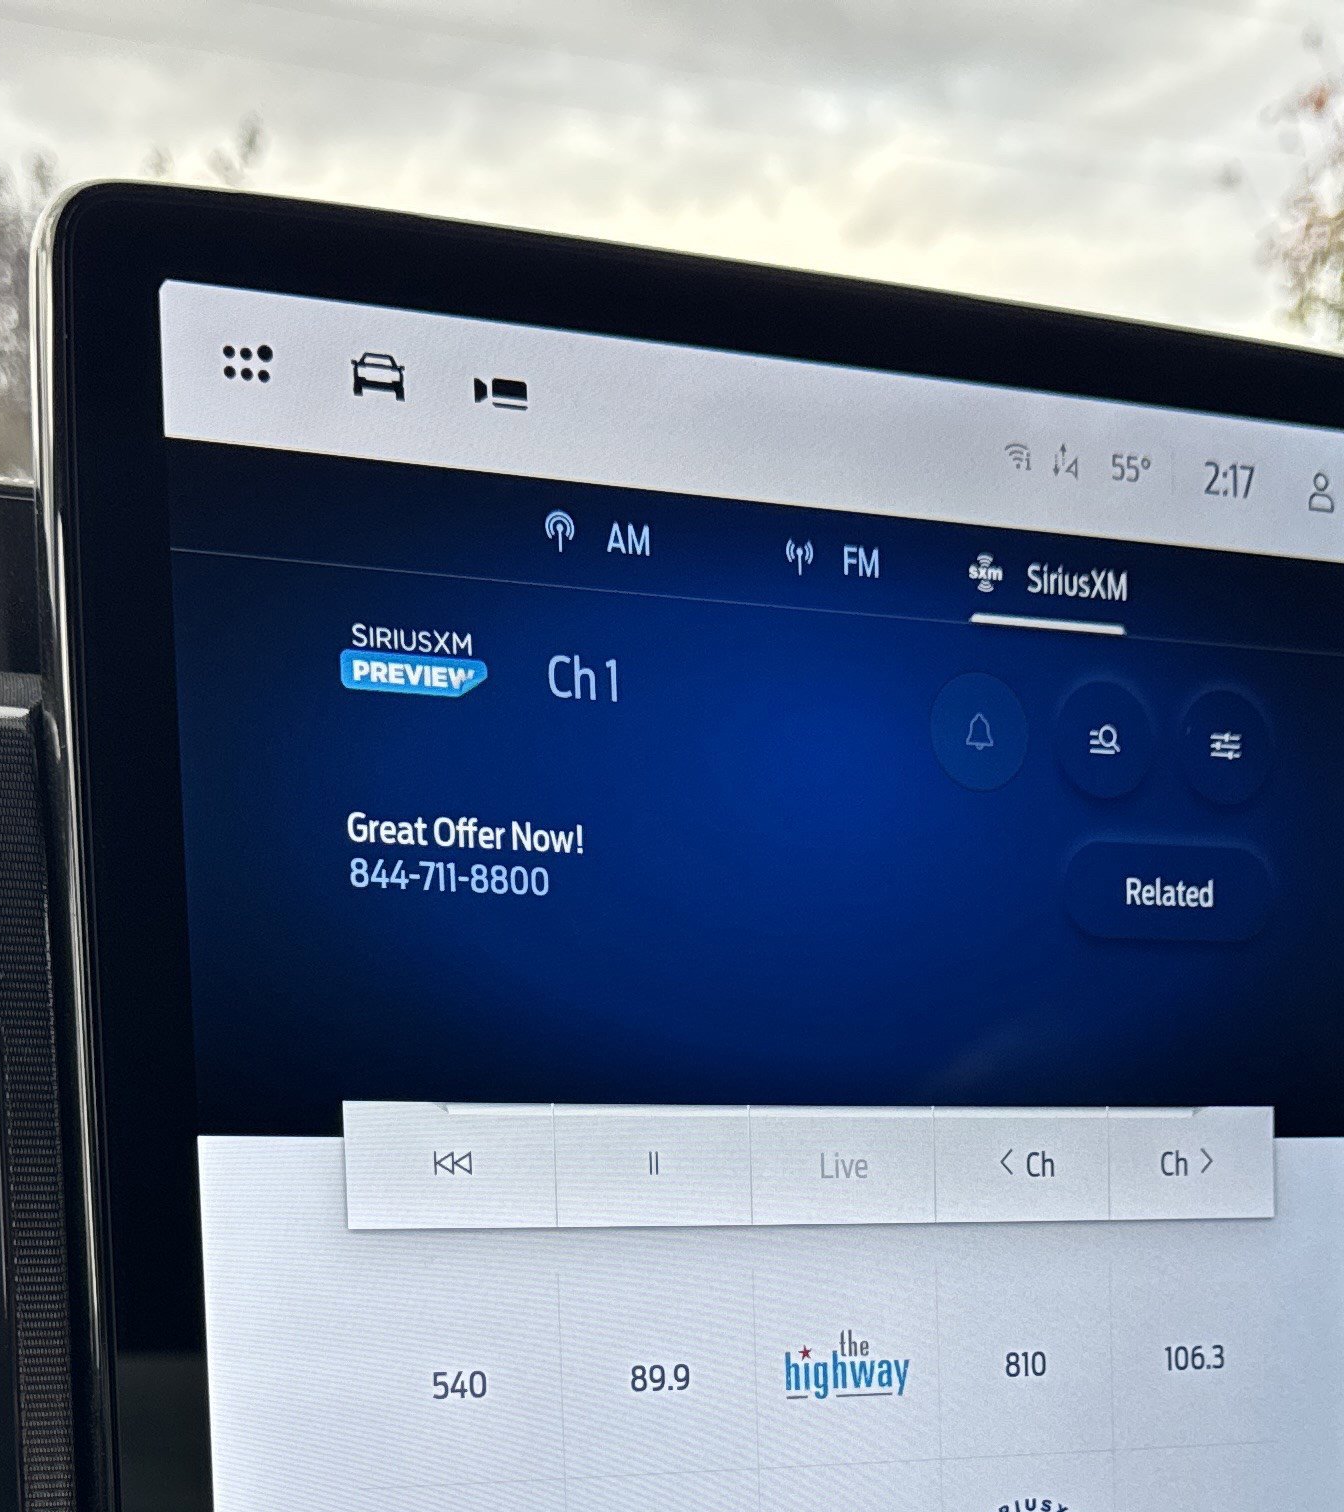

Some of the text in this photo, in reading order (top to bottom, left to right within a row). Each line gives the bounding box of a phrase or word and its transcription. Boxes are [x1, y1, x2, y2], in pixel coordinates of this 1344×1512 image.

[1204, 461, 1255, 498] 2:17
[606, 523, 651, 556] AM
[843, 546, 880, 578] FM
[1026, 561, 1128, 601] SiriusXM
[351, 623, 473, 656] SIRIUSXM
[352, 660, 475, 690] PREVIEW
[548, 654, 619, 702] Ch 1
[346, 811, 584, 855] Great Offer Now!
[349, 857, 549, 896] 844-711-8800
[1125, 877, 1214, 909] Related
[819, 1151, 869, 1180] Live
[1025, 1150, 1055, 1179] Ch
[1160, 1150, 1189, 1177] Ch
[839, 1329, 870, 1358] the
[1164, 1343, 1226, 1372] 106.3
[630, 1363, 690, 1392] 89.9
[784, 1348, 911, 1400] highway
[1004, 1350, 1048, 1378] 810
[432, 1370, 488, 1400] 540
